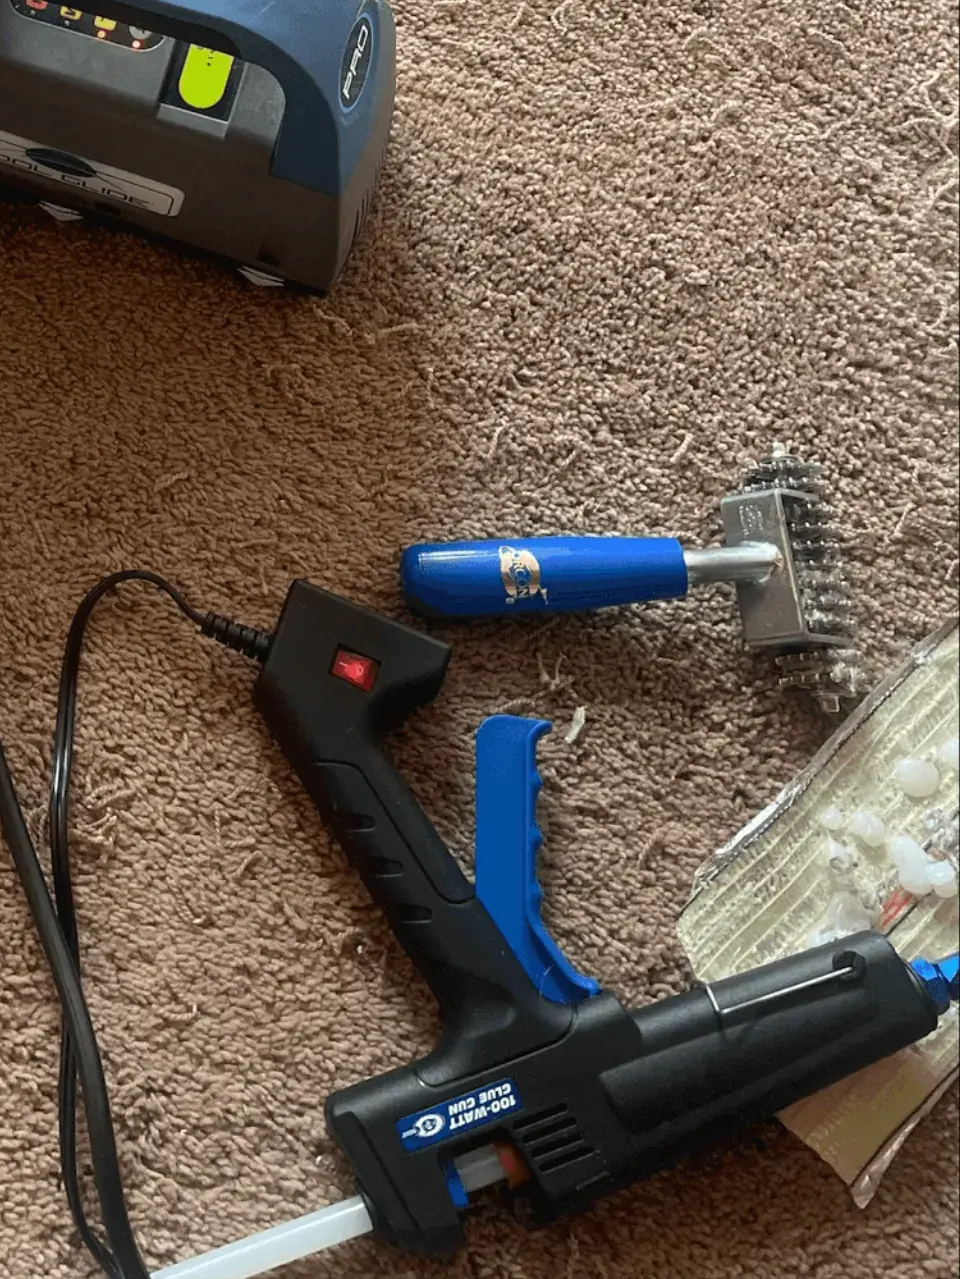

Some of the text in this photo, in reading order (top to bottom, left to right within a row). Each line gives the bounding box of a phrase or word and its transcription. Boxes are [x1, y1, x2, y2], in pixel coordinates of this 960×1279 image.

[342, 24, 368, 99] PRO
[448, 1083, 512, 1116] GLUE GUN
[449, 1094, 516, 1130] 100-WATT
